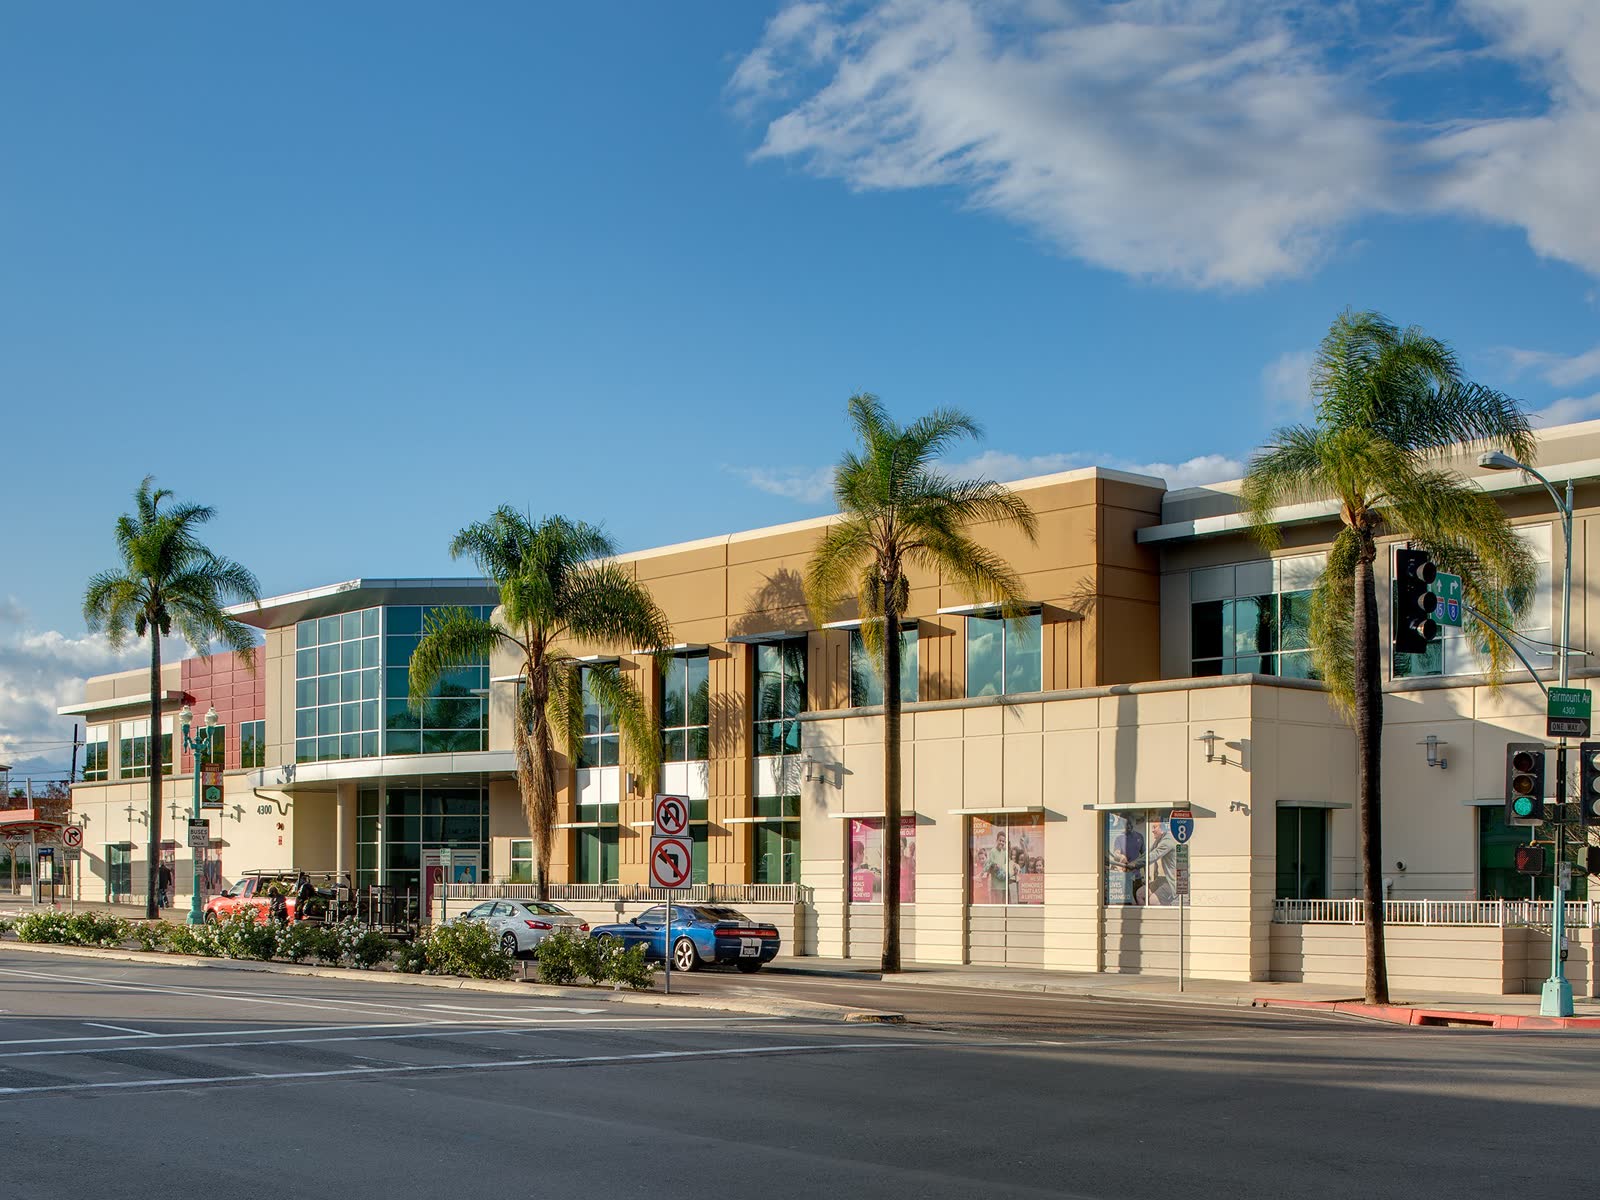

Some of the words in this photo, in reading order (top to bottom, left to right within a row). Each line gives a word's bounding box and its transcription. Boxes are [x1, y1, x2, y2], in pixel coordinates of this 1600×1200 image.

[1549, 691, 1581, 703] Fairmount
[1562, 706, 1576, 715] 4300
[1553, 722, 1564, 731] ONE
[1568, 723, 1578, 731] WAY
[257, 804, 272, 815] 4300
[1178, 825, 1187, 841] 8
